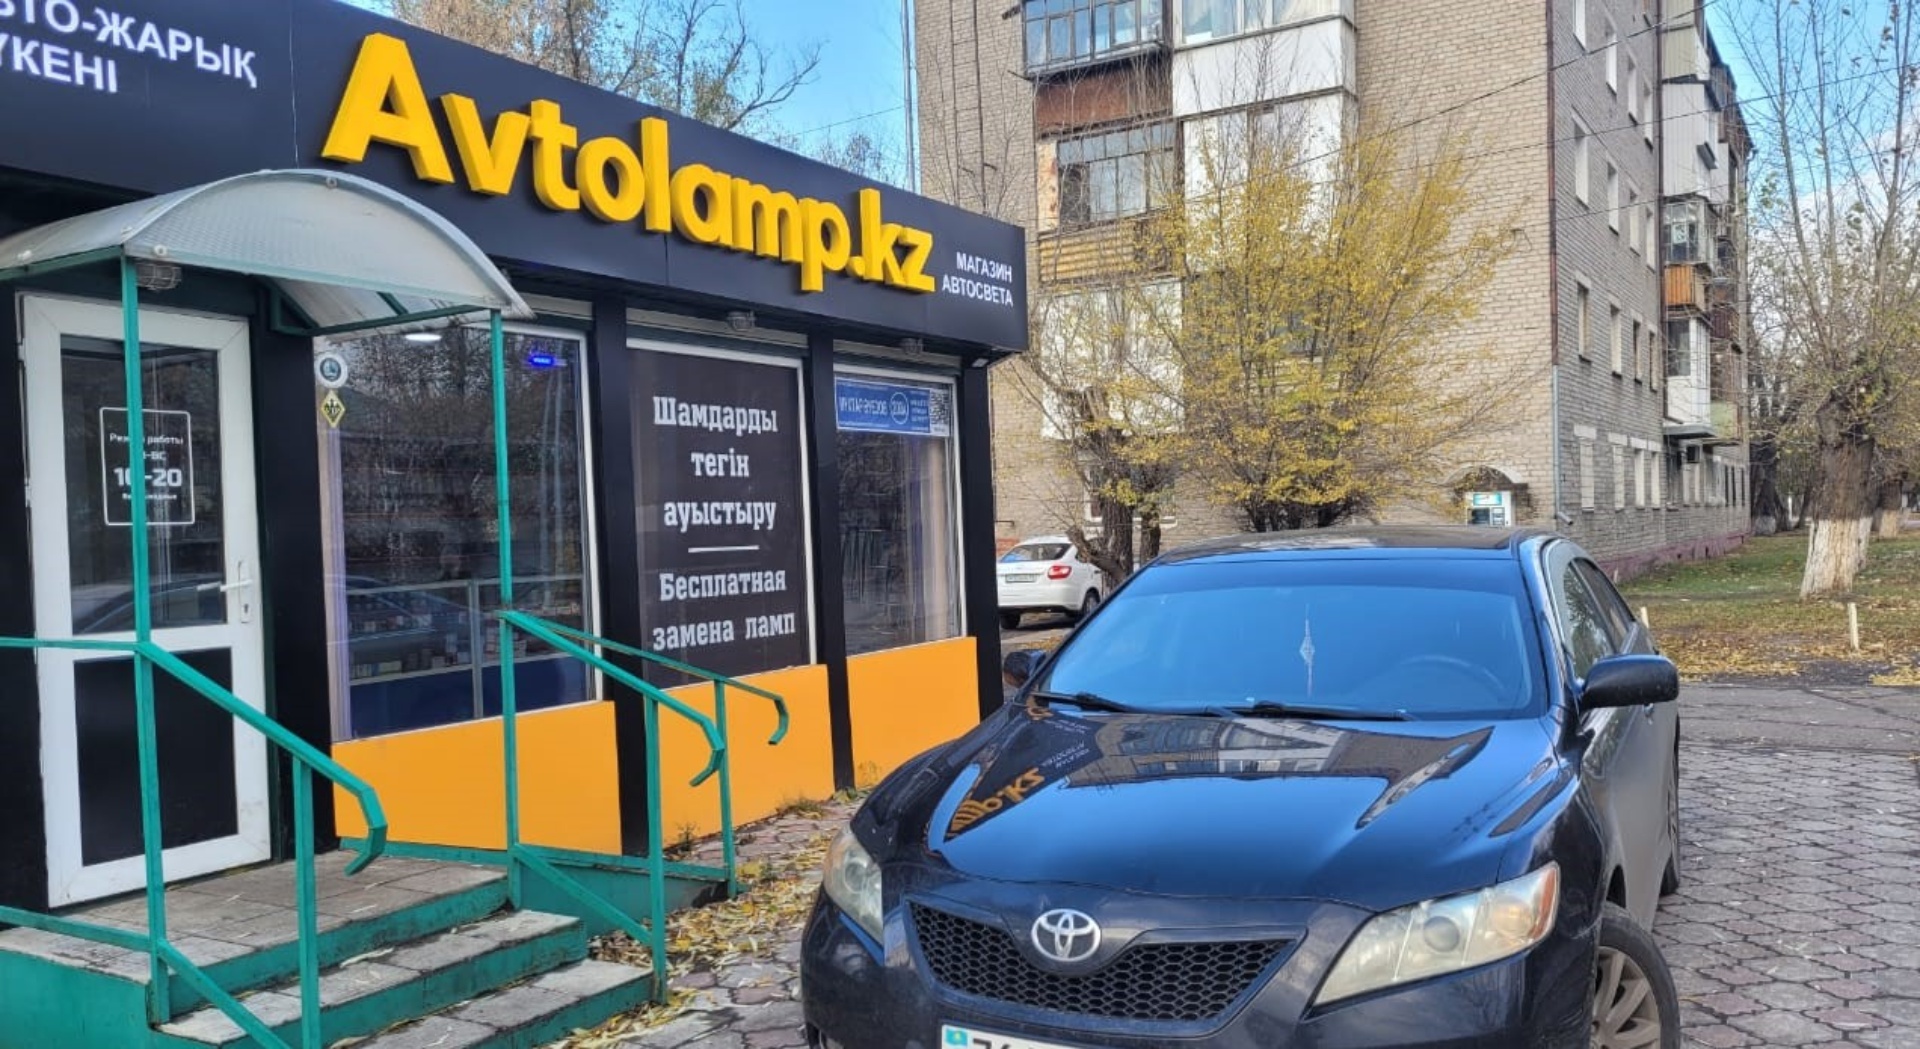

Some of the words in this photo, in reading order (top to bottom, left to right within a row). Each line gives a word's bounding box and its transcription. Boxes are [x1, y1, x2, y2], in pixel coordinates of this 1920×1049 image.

[321, 33, 935, 292] Avtolamp.kz
[956, 251, 1012, 284] МАГАЗИН
[942, 273, 1014, 308] АВТОСВЕТА
[653, 396, 778, 436] Шамдарды
[691, 448, 750, 477] тегін
[664, 502, 777, 533] ауыстыру
[659, 569, 787, 601] Бесплатная
[653, 619, 735, 651] замена
[745, 612, 796, 640] ламп
